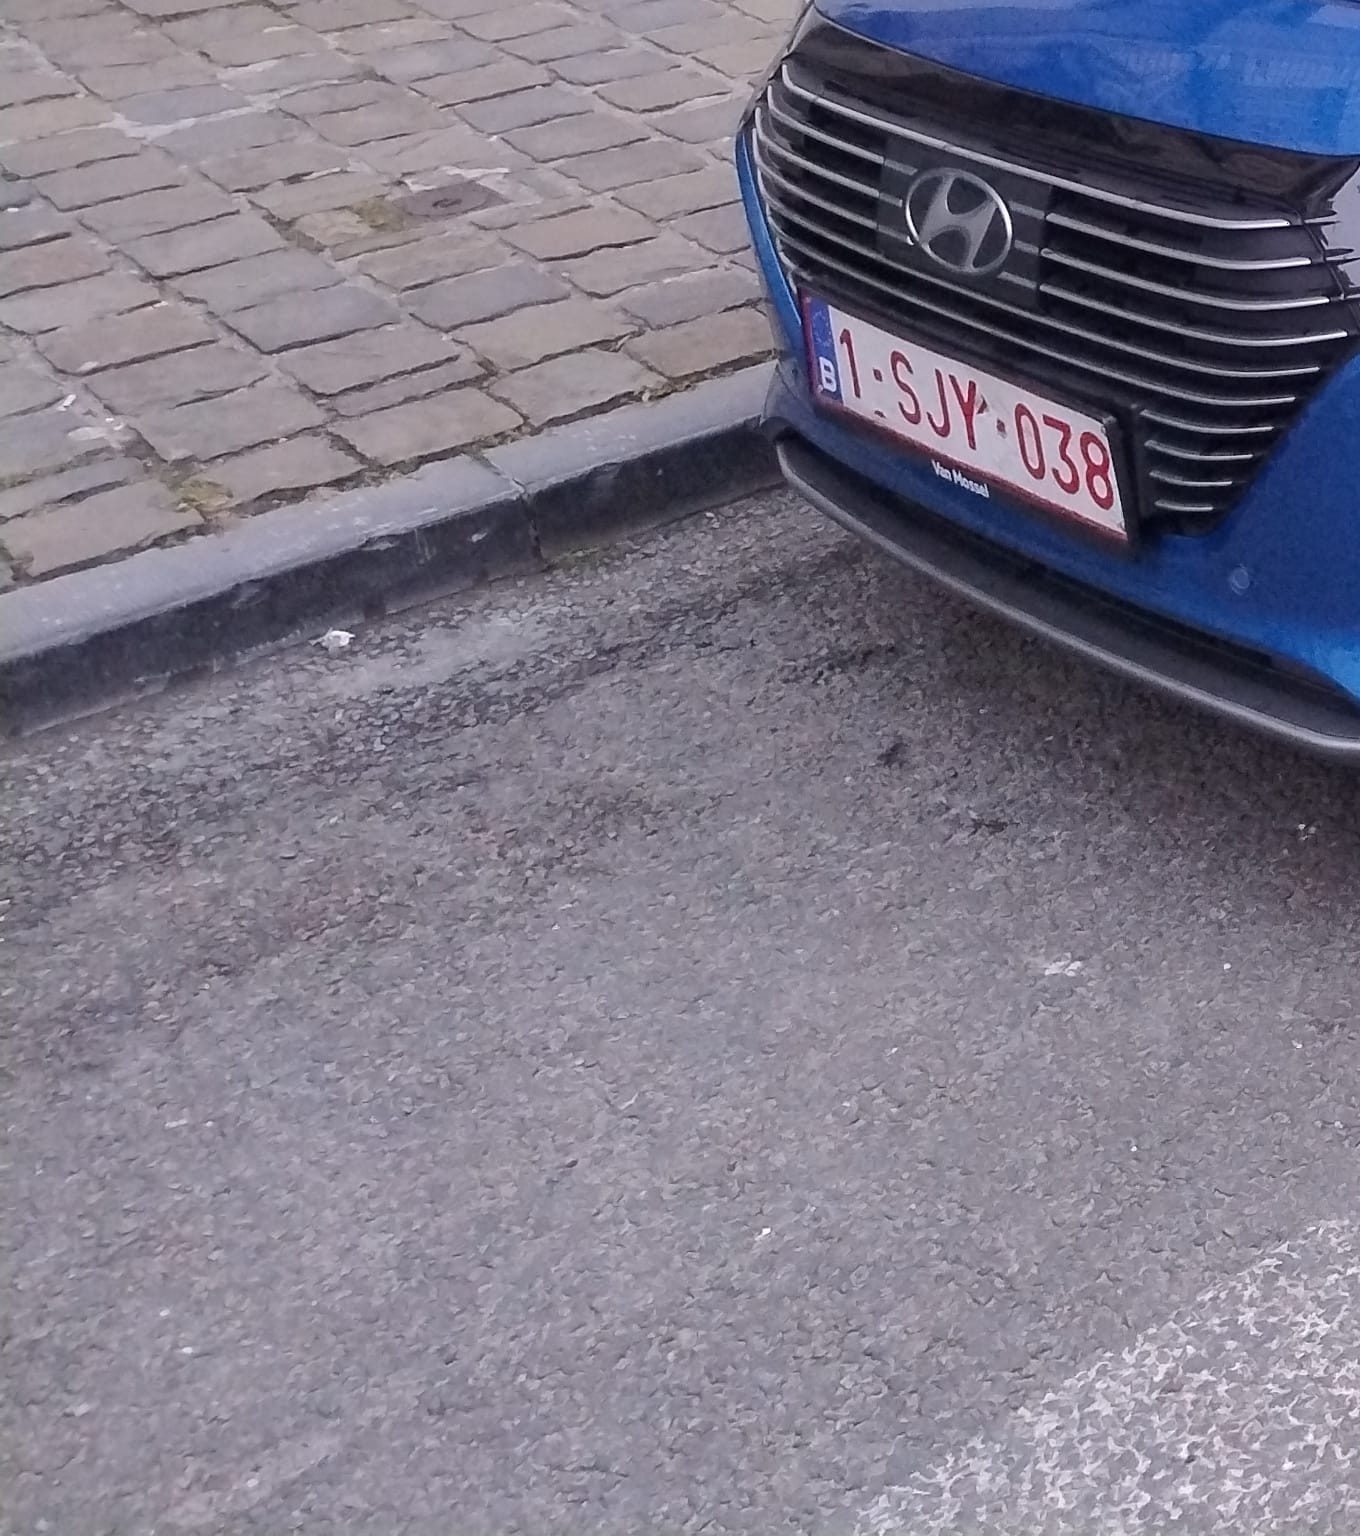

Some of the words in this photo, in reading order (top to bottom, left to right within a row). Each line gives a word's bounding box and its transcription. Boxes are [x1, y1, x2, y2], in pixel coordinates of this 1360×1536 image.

[819, 356, 838, 393] B
[840, 328, 1114, 511] 1-SJY-038
[931, 458, 953, 482] Van
[951, 468, 990, 499] Mossel
